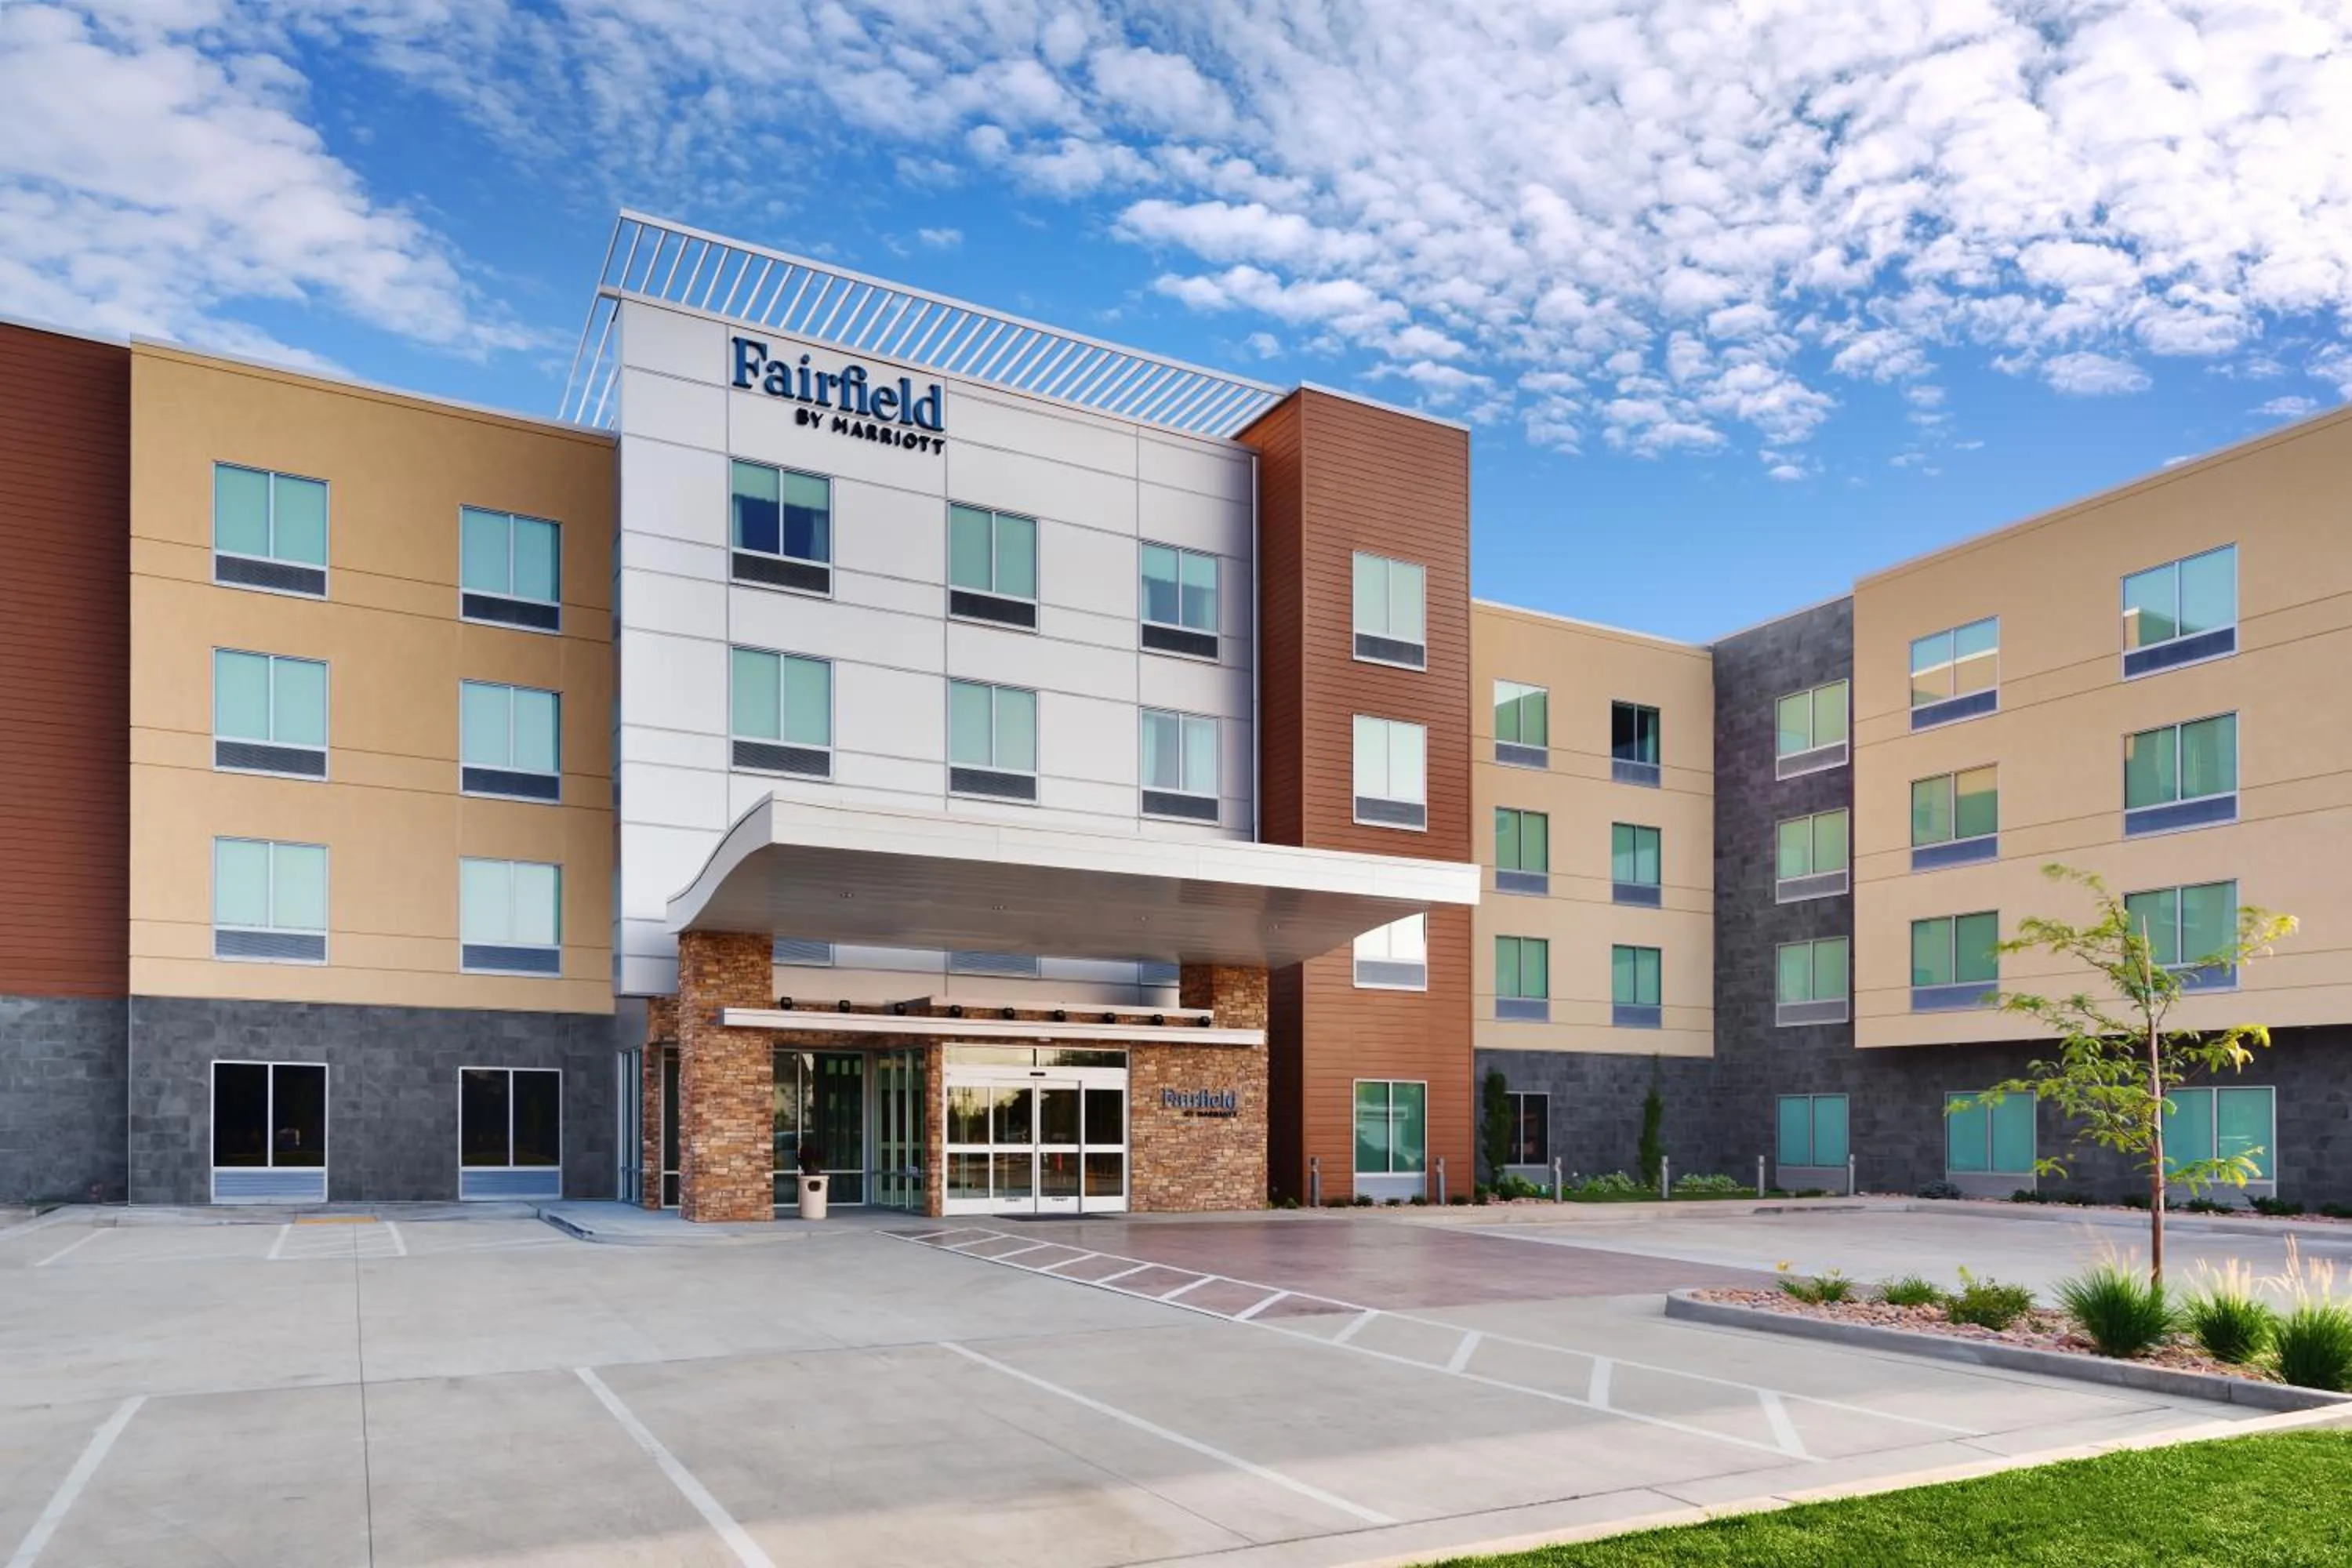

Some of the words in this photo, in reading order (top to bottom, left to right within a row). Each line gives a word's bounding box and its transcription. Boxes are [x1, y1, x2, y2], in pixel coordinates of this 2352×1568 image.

[731, 336, 945, 433] Fairfield
[795, 408, 824, 429] BY
[832, 416, 946, 456] MARRIOTT
[1161, 1087, 1236, 1109] Fairfield
